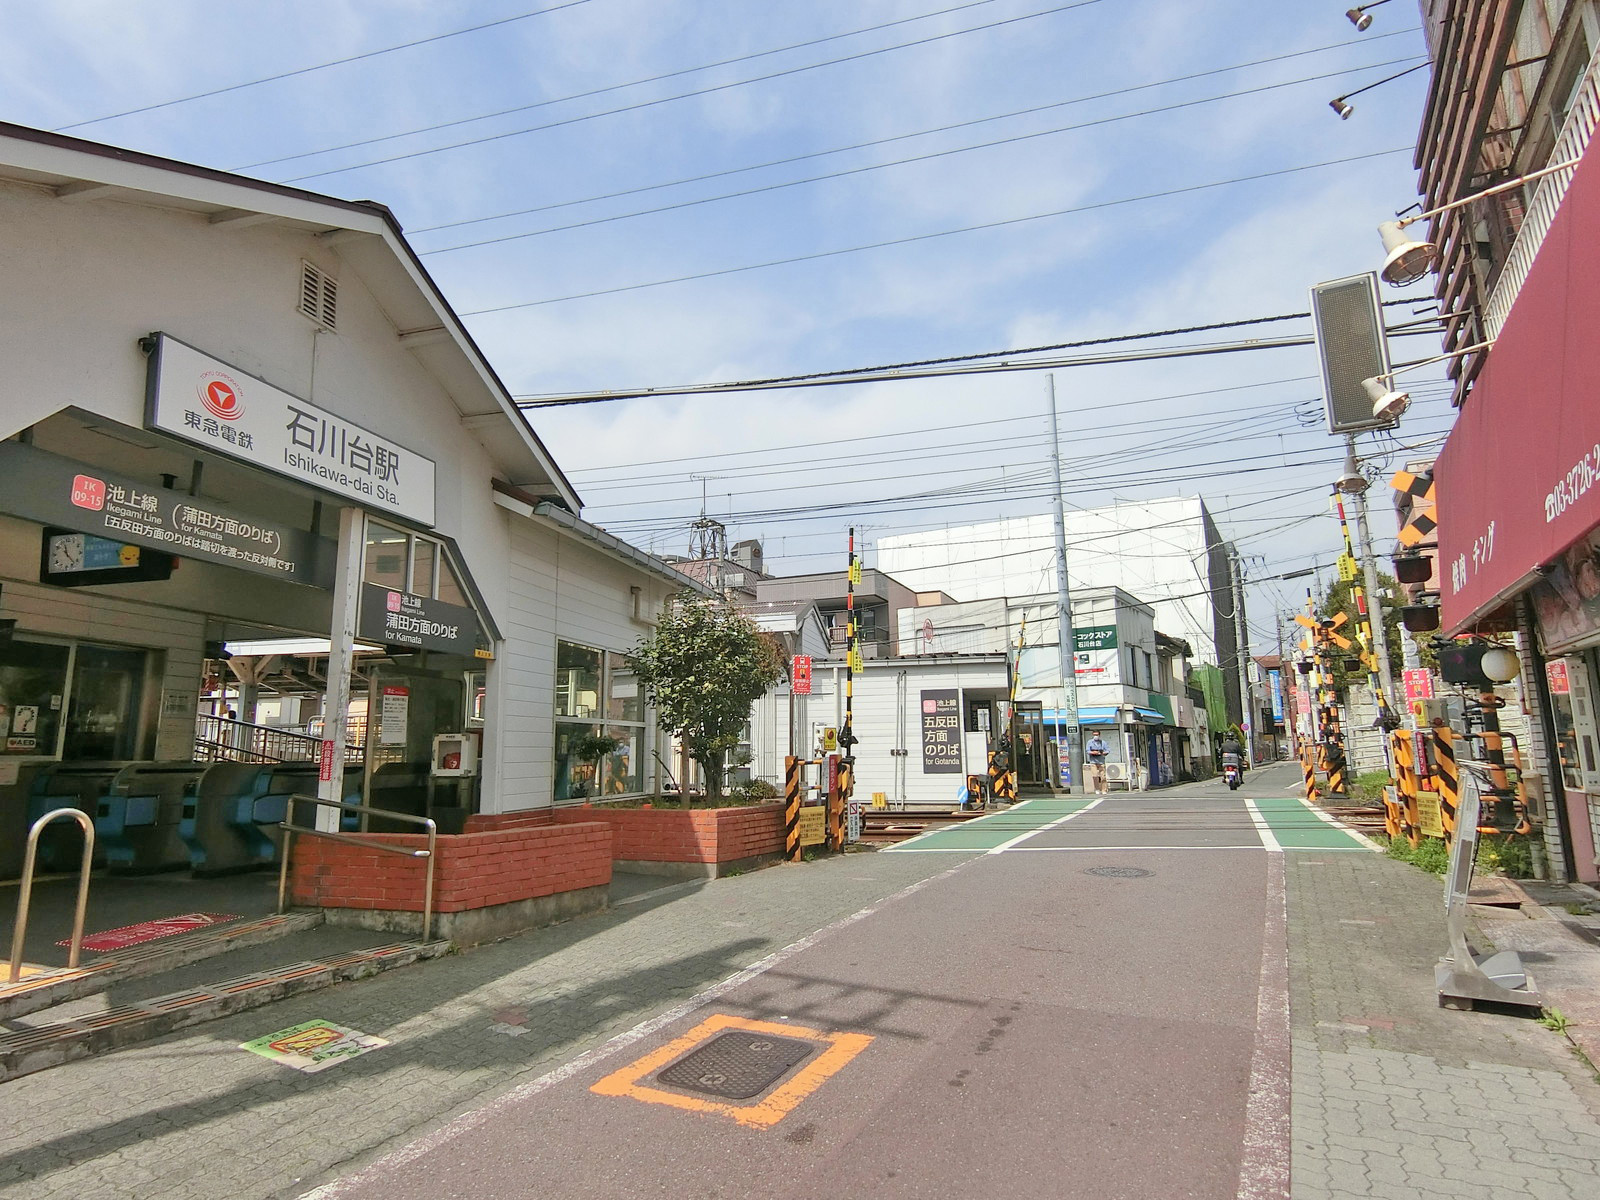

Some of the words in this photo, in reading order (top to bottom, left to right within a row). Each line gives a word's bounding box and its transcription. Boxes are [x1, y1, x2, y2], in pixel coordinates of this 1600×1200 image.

[184, 409, 254, 451] 東急電鉄
[286, 404, 399, 486] 石川台駅
[284, 447, 373, 496] Ishikawa-dai
[376, 484, 400, 506] Sta.
[84, 481, 97, 492] IK
[106, 483, 158, 513] 池上線
[106, 502, 143, 520] Ikegami
[144, 512, 163, 525] Line
[181, 523, 193, 533] for
[193, 525, 223, 542] Kamata
[386, 611, 458, 640] 蒲田方面のりば
[385, 630, 396, 639] for
[396, 632, 422, 645] Kamata
[1077, 640, 1102, 648] 石川台店
[924, 716, 958, 728] 五反田
[17, 738, 35, 746] AED
[925, 730, 948, 742] 方面
[925, 744, 960, 756] のりば
